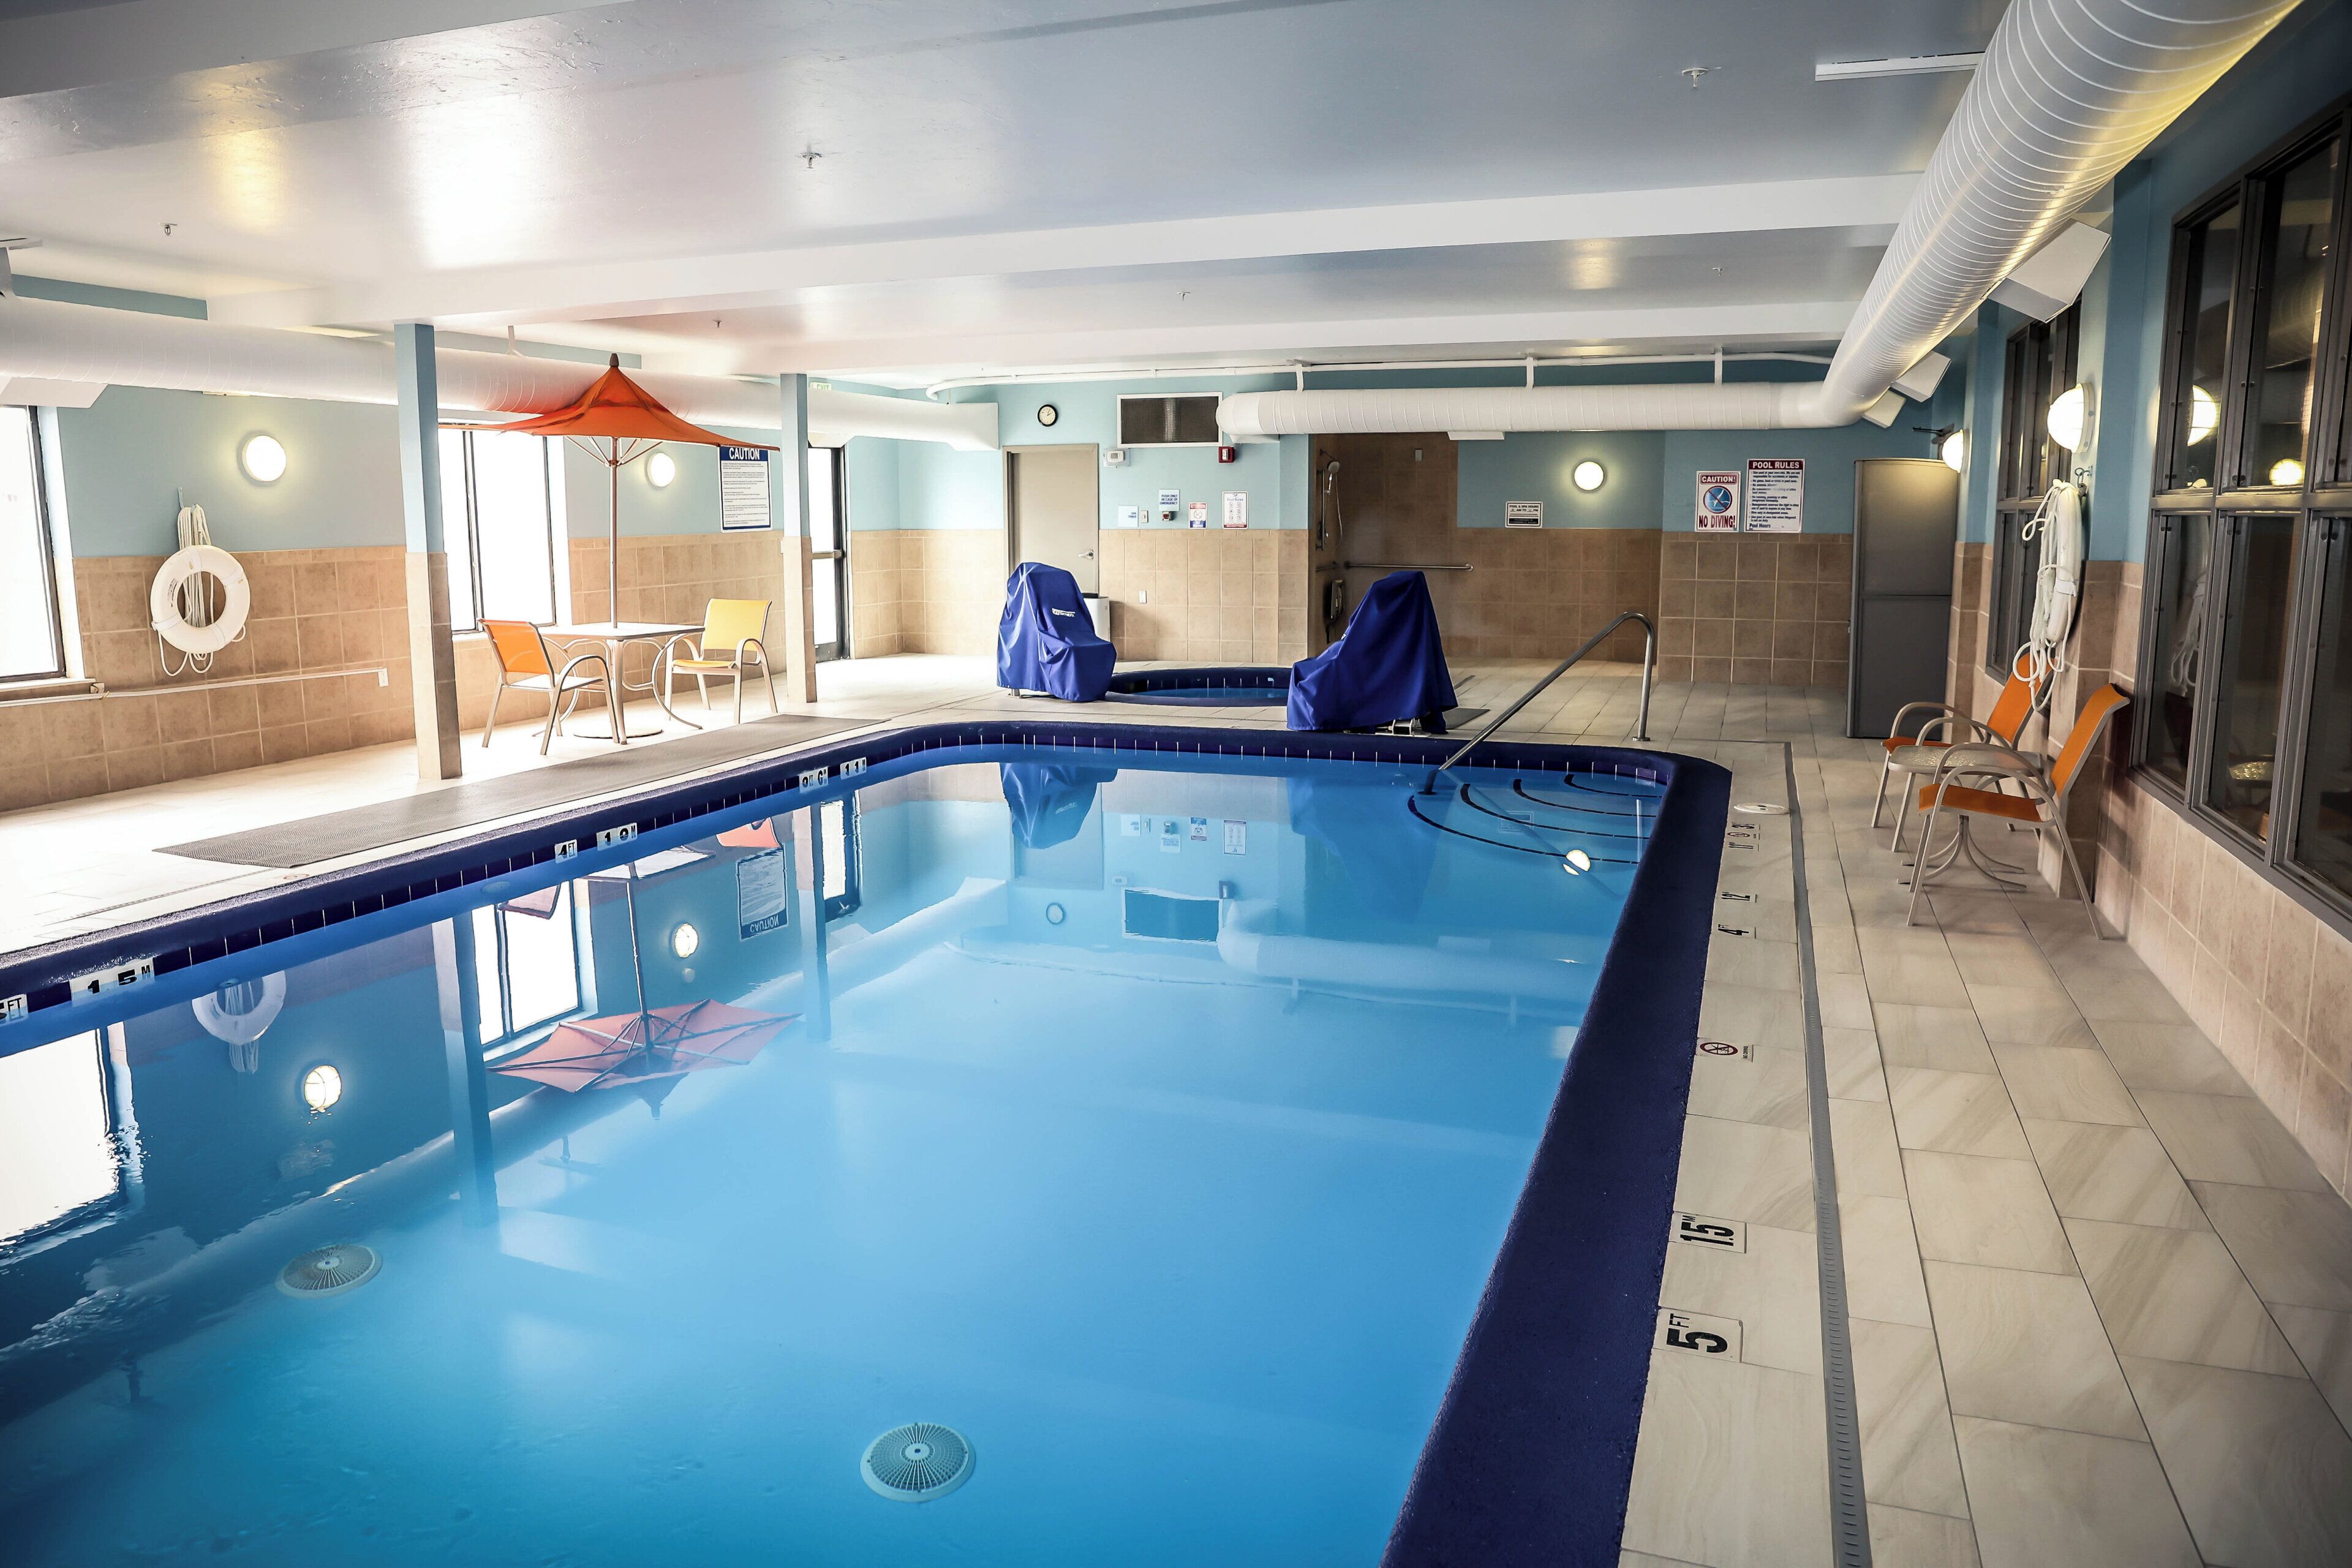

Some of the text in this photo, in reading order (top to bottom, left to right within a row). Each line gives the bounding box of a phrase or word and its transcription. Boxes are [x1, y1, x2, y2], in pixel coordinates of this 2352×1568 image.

[729, 448, 760, 460] CAUTION
[1698, 514, 1736, 529] NO DIVING!
